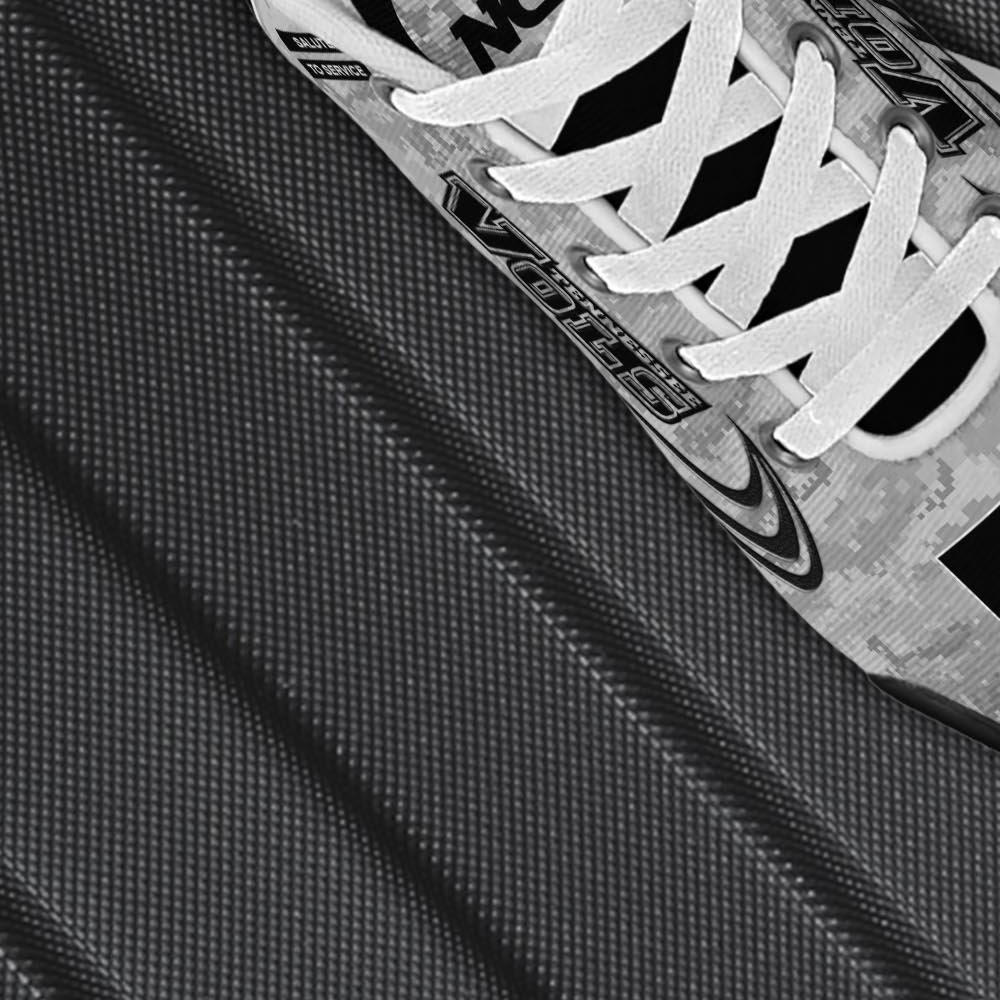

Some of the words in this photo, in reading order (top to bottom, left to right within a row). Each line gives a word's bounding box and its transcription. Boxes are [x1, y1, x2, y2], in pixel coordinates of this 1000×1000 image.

[306, 63, 325, 76] TO
[321, 63, 368, 77] SERVICE
[439, 170, 697, 424] VOLS
[550, 266, 702, 409] TENNESSEE
